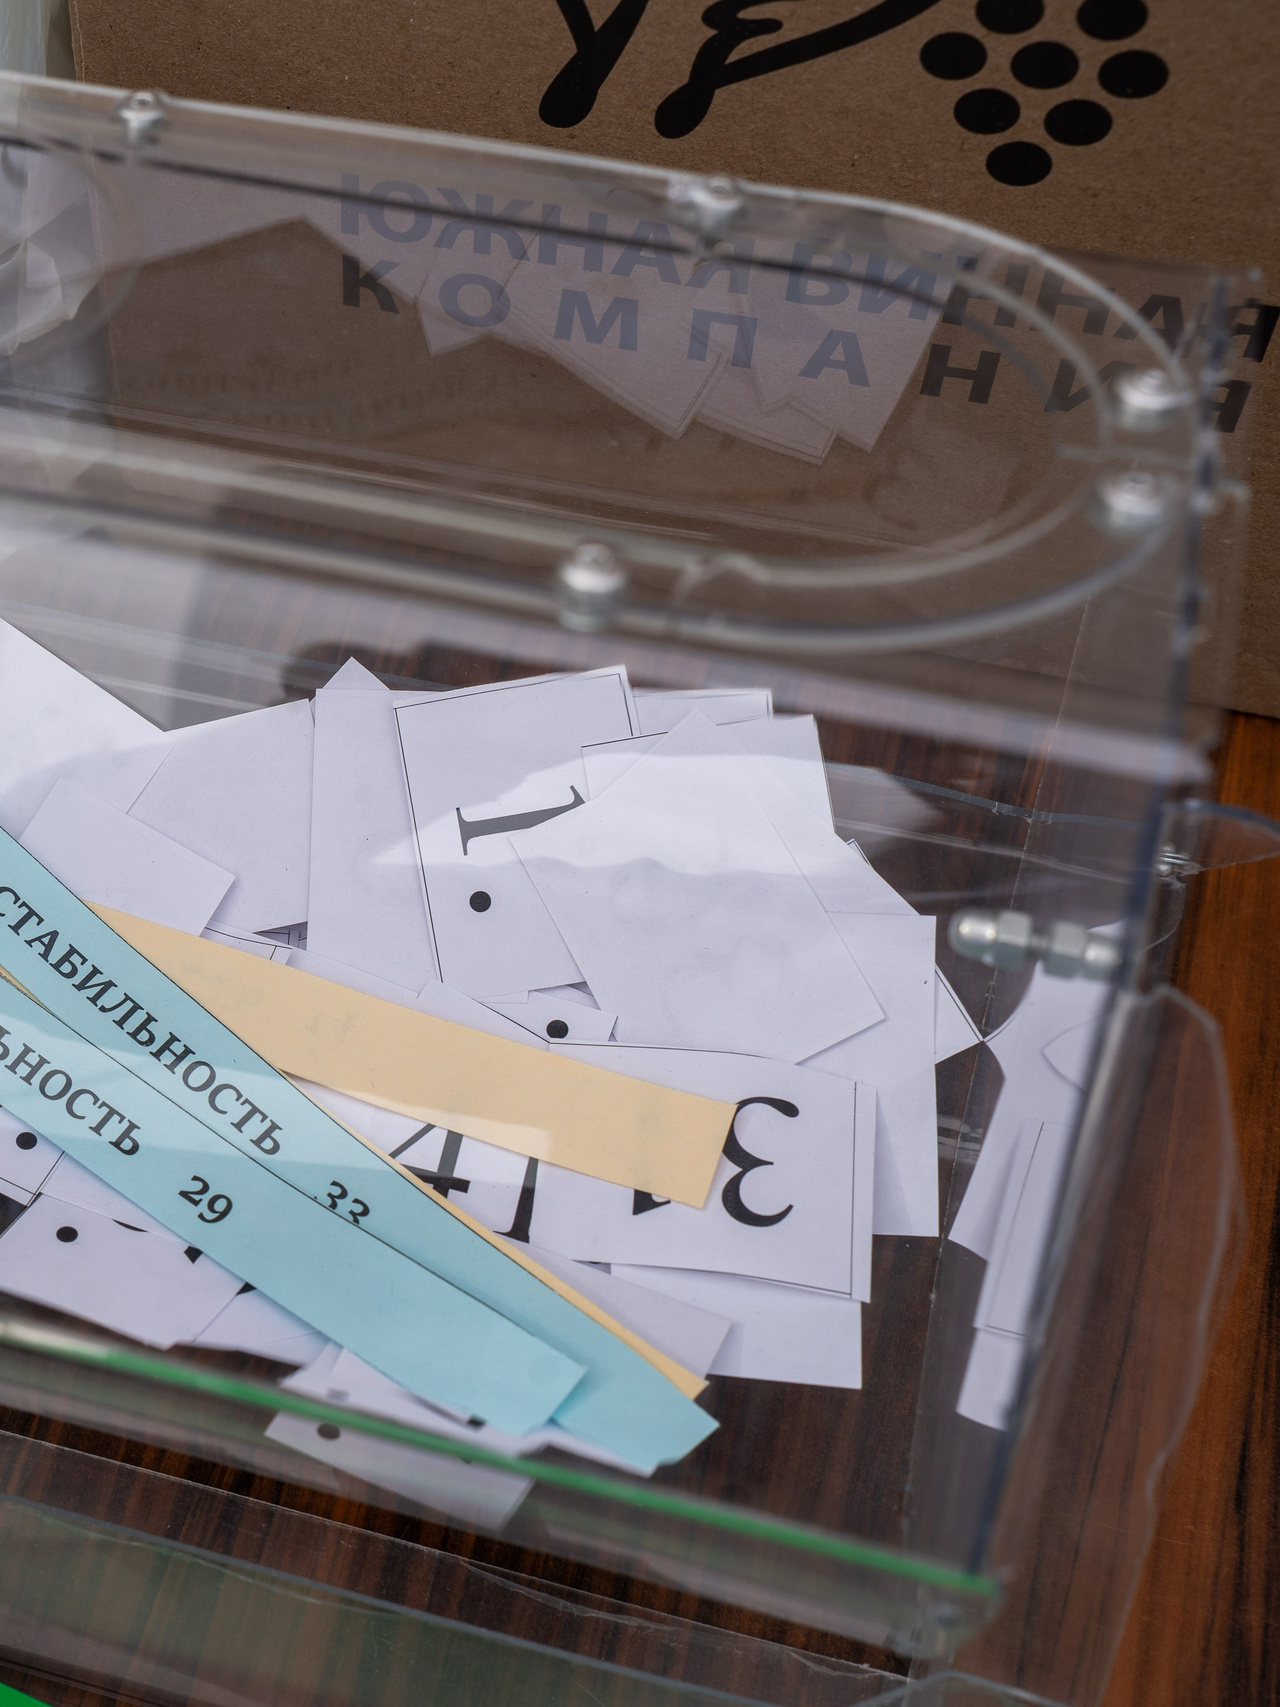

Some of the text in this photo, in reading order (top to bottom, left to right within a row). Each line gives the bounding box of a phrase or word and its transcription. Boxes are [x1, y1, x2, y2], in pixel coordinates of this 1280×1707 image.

[340, 173, 1279, 363] ЮЖНАЯ ВИННАЯ
[178, 1175, 234, 1224] 29
